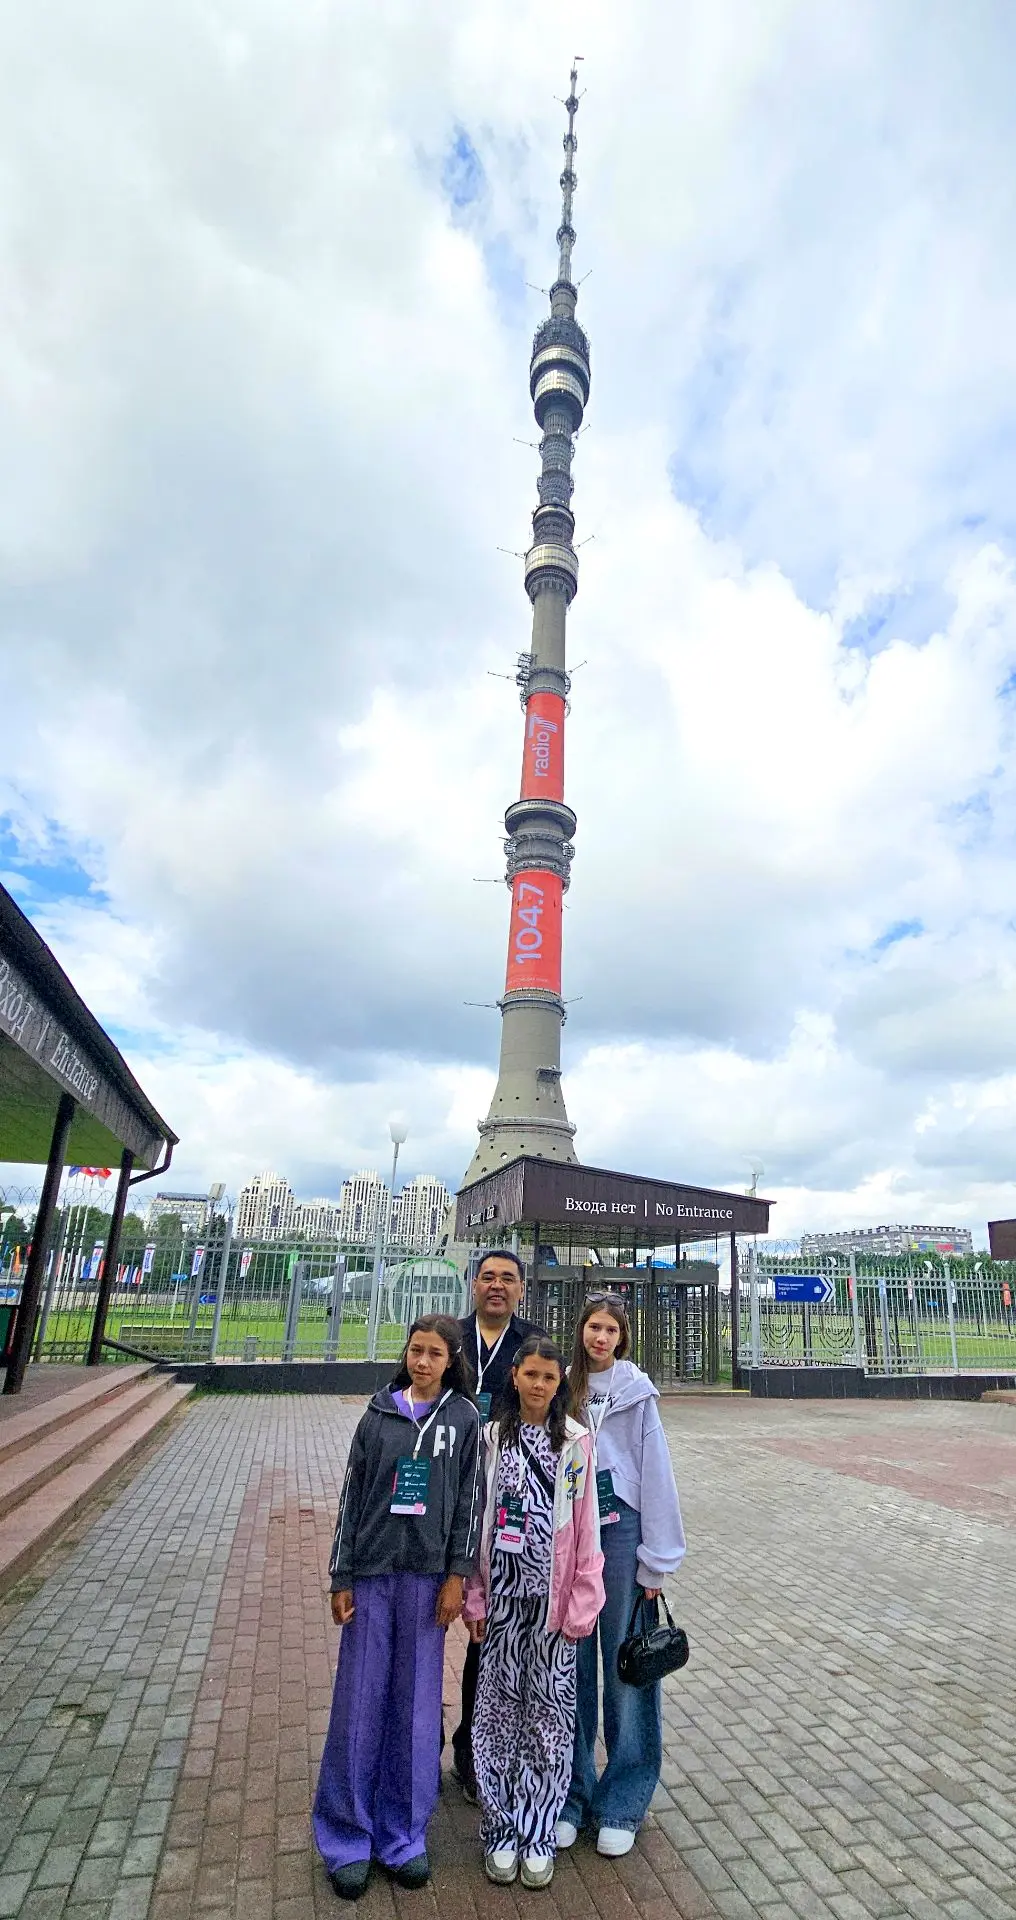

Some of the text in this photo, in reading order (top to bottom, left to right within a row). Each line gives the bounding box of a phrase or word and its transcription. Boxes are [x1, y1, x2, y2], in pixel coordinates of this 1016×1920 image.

[515, 882, 544, 964] 104.7
[50, 1032, 99, 1101] Entrance
[565, 1197, 637, 1214] Входа нет
[655, 1203, 733, 1219] No Entrance
